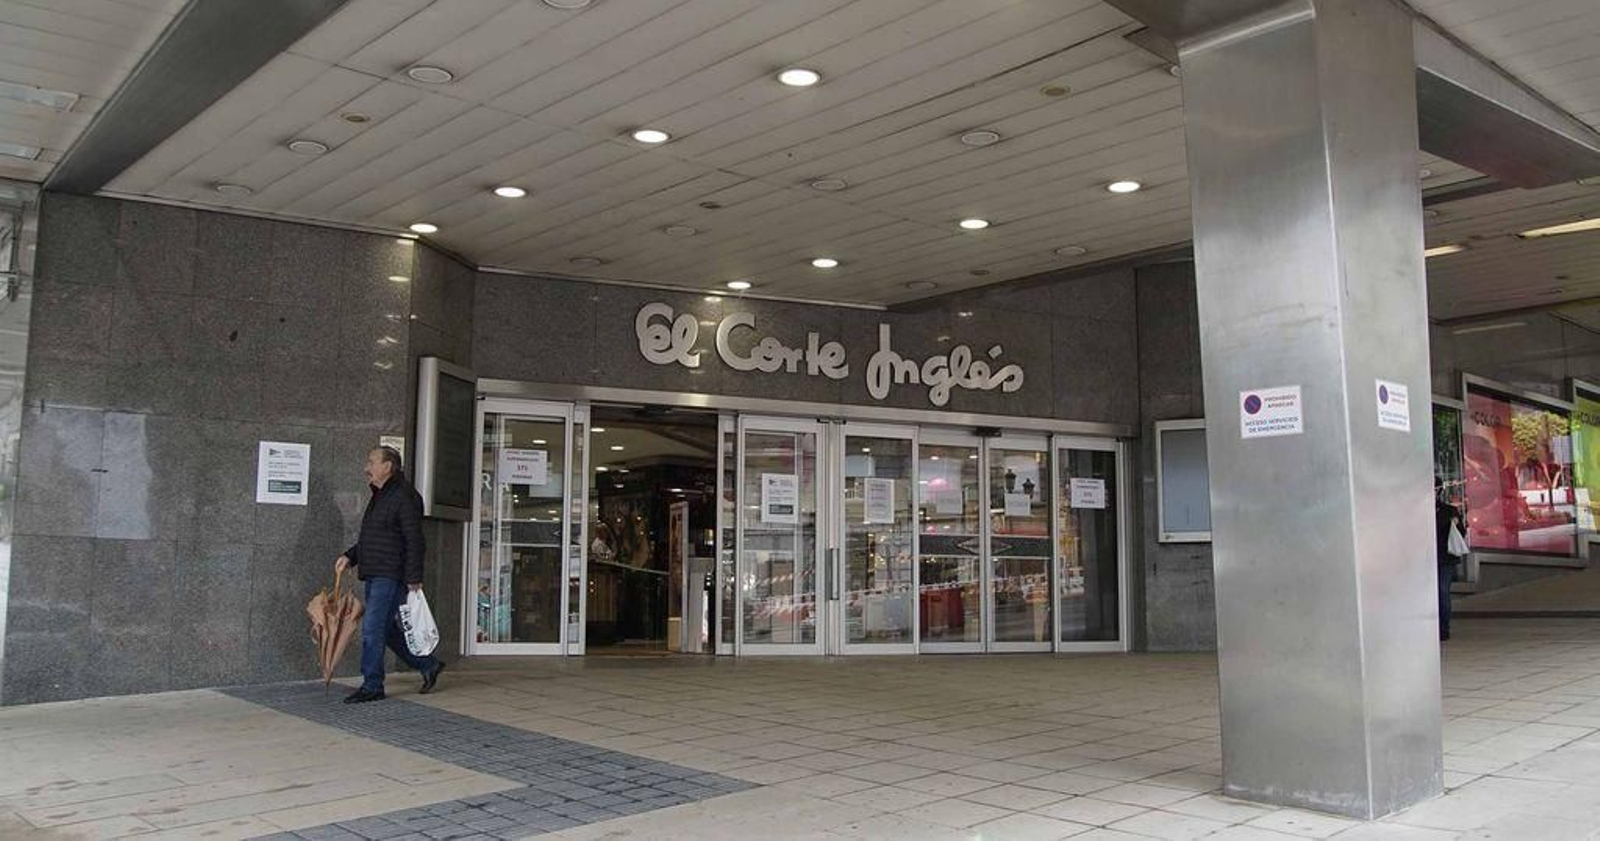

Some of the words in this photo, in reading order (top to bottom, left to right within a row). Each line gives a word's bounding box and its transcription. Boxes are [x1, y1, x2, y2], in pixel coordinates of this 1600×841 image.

[635, 302, 700, 368] El
[716, 312, 849, 380] Corte
[866, 323, 1025, 407] Inglés
